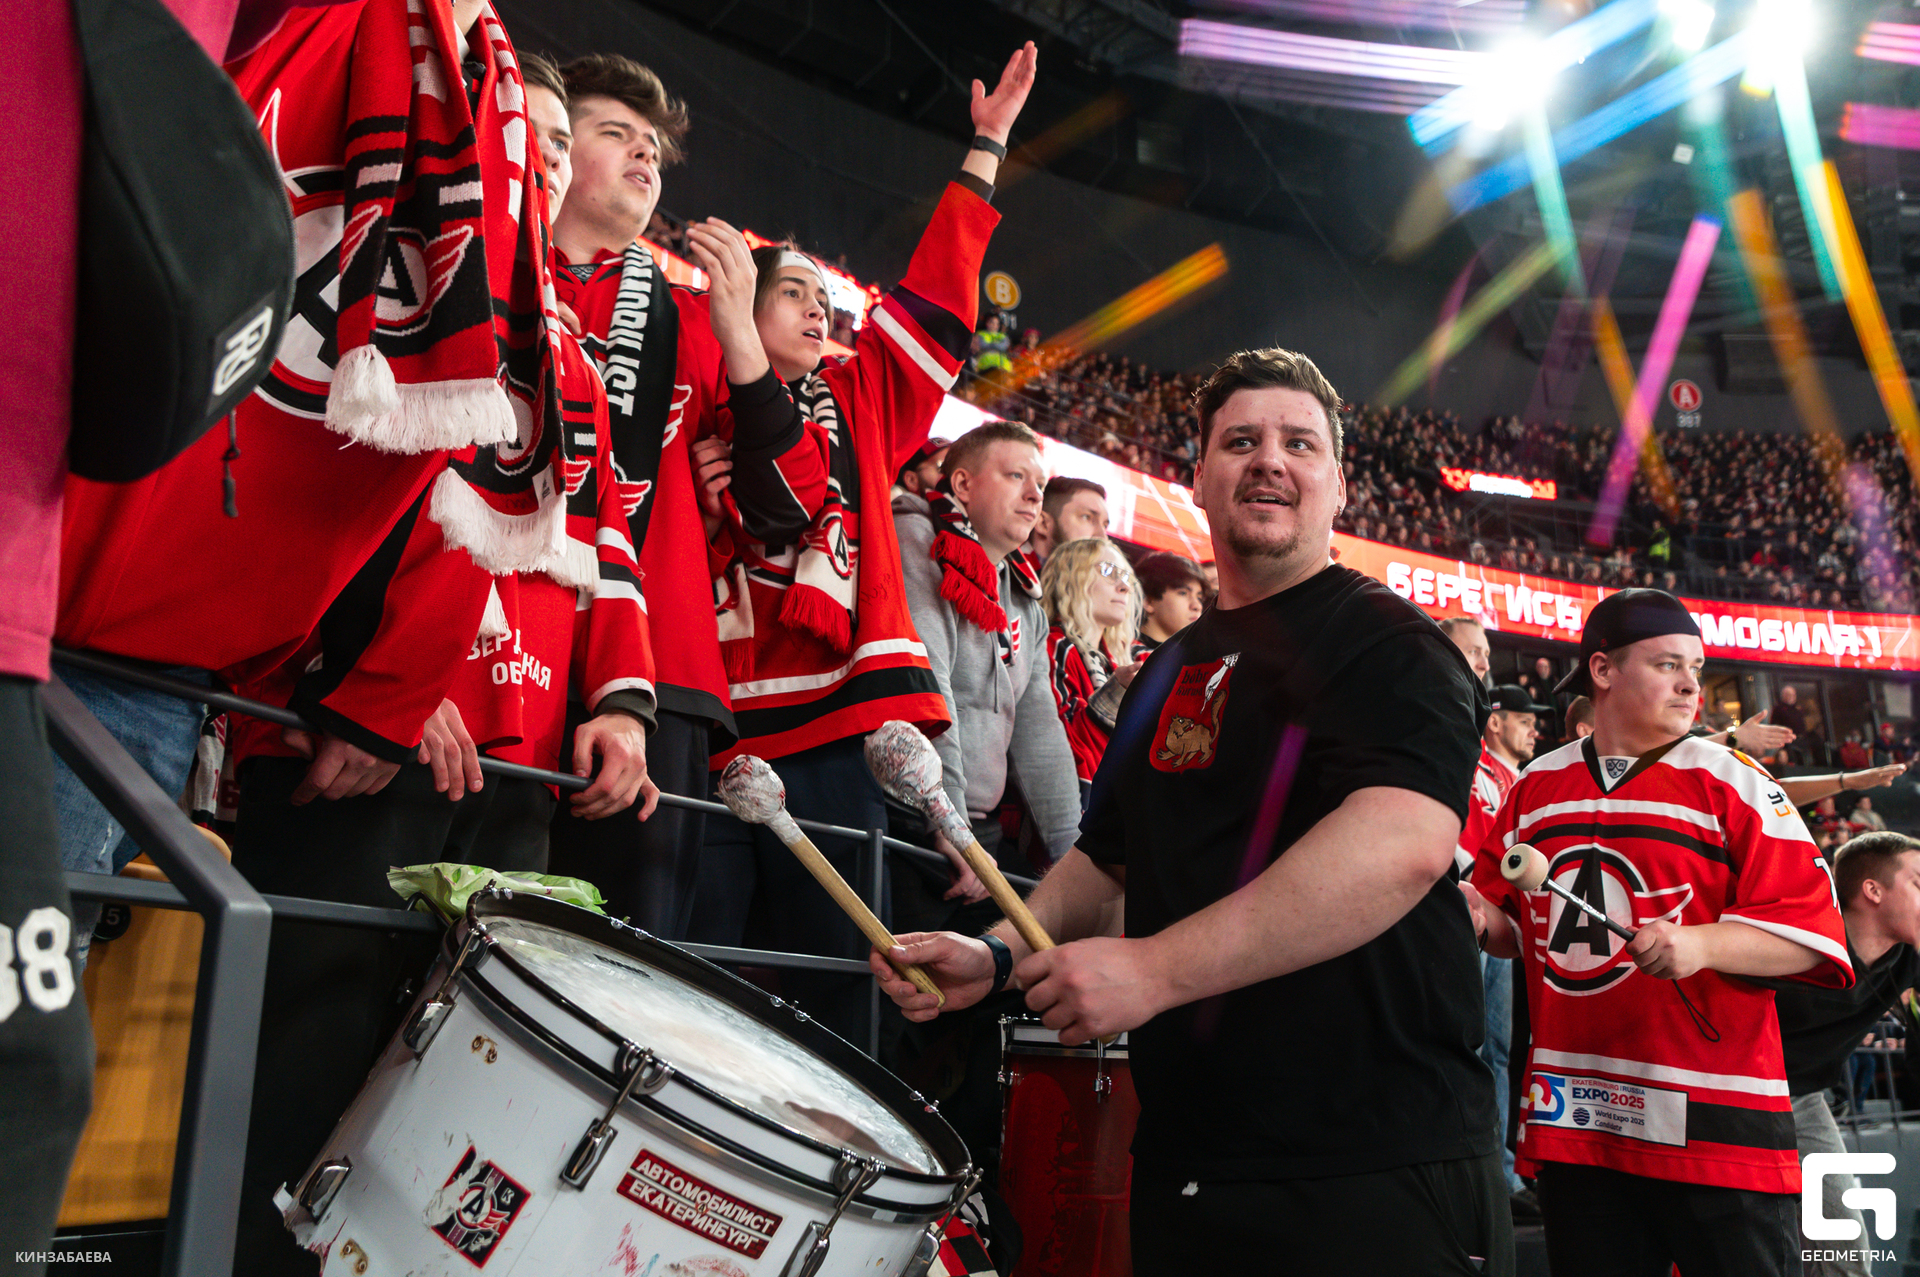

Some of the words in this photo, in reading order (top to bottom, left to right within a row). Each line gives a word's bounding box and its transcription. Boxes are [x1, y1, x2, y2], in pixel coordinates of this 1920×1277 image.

[1679, 384, 1695, 408] A
[1571, 1078, 1619, 1091] EKATERINBURG
[1622, 1085, 1646, 1096] RUSSIA
[1594, 1109, 1612, 1120] World
[1613, 1113, 1630, 1123] Expo
[1630, 1116, 1645, 1126] 2025
[1594, 1119, 1623, 1132] Candidate
[636, 1158, 775, 1234] АВТОМОБИЛИСТ
[628, 1178, 760, 1250] ЕКАТЕРИНБУРГ
